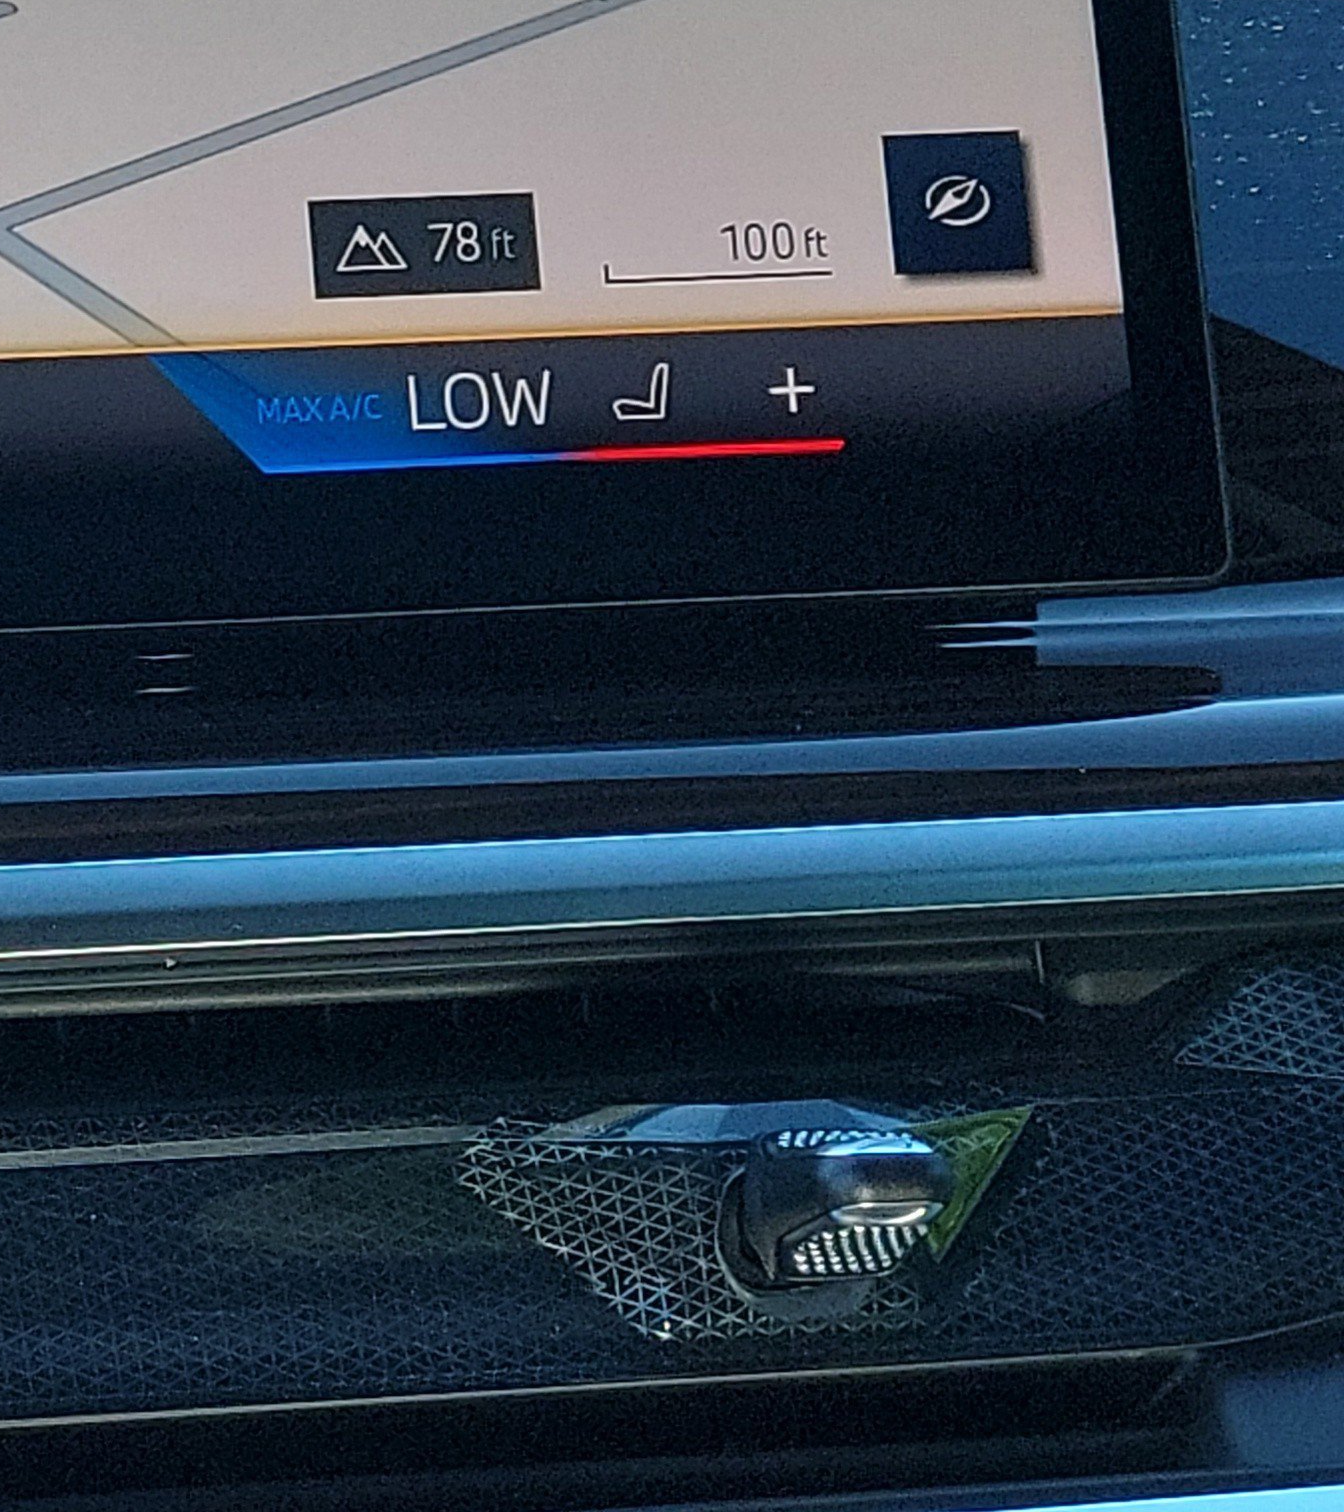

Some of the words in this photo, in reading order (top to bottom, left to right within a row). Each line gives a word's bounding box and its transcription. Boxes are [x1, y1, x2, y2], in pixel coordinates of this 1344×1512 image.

[426, 221, 482, 263] 78
[491, 227, 516, 260] ft
[720, 222, 796, 262] 100
[802, 227, 828, 259] ft
[256, 394, 324, 425] MAX
[330, 393, 383, 420] A/C
[406, 369, 551, 431] LOW
